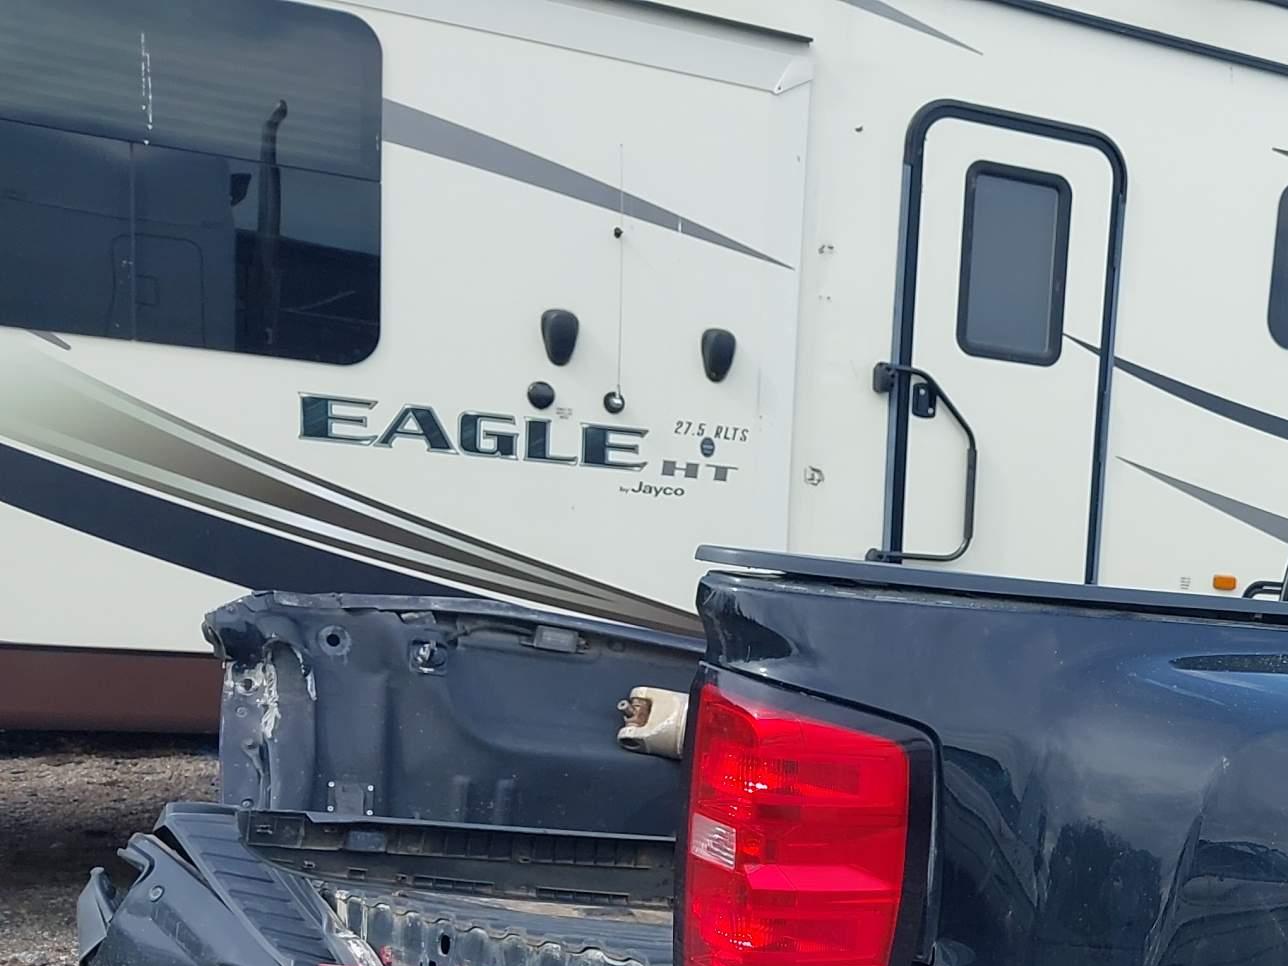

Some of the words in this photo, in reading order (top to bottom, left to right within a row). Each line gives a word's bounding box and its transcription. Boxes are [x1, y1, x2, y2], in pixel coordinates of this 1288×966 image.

[297, 391, 649, 472] EAGLE
[674, 420, 706, 437] 27.5
[714, 425, 750, 442] RLTS
[661, 459, 738, 482] HT
[631, 481, 685, 497] Jayco
